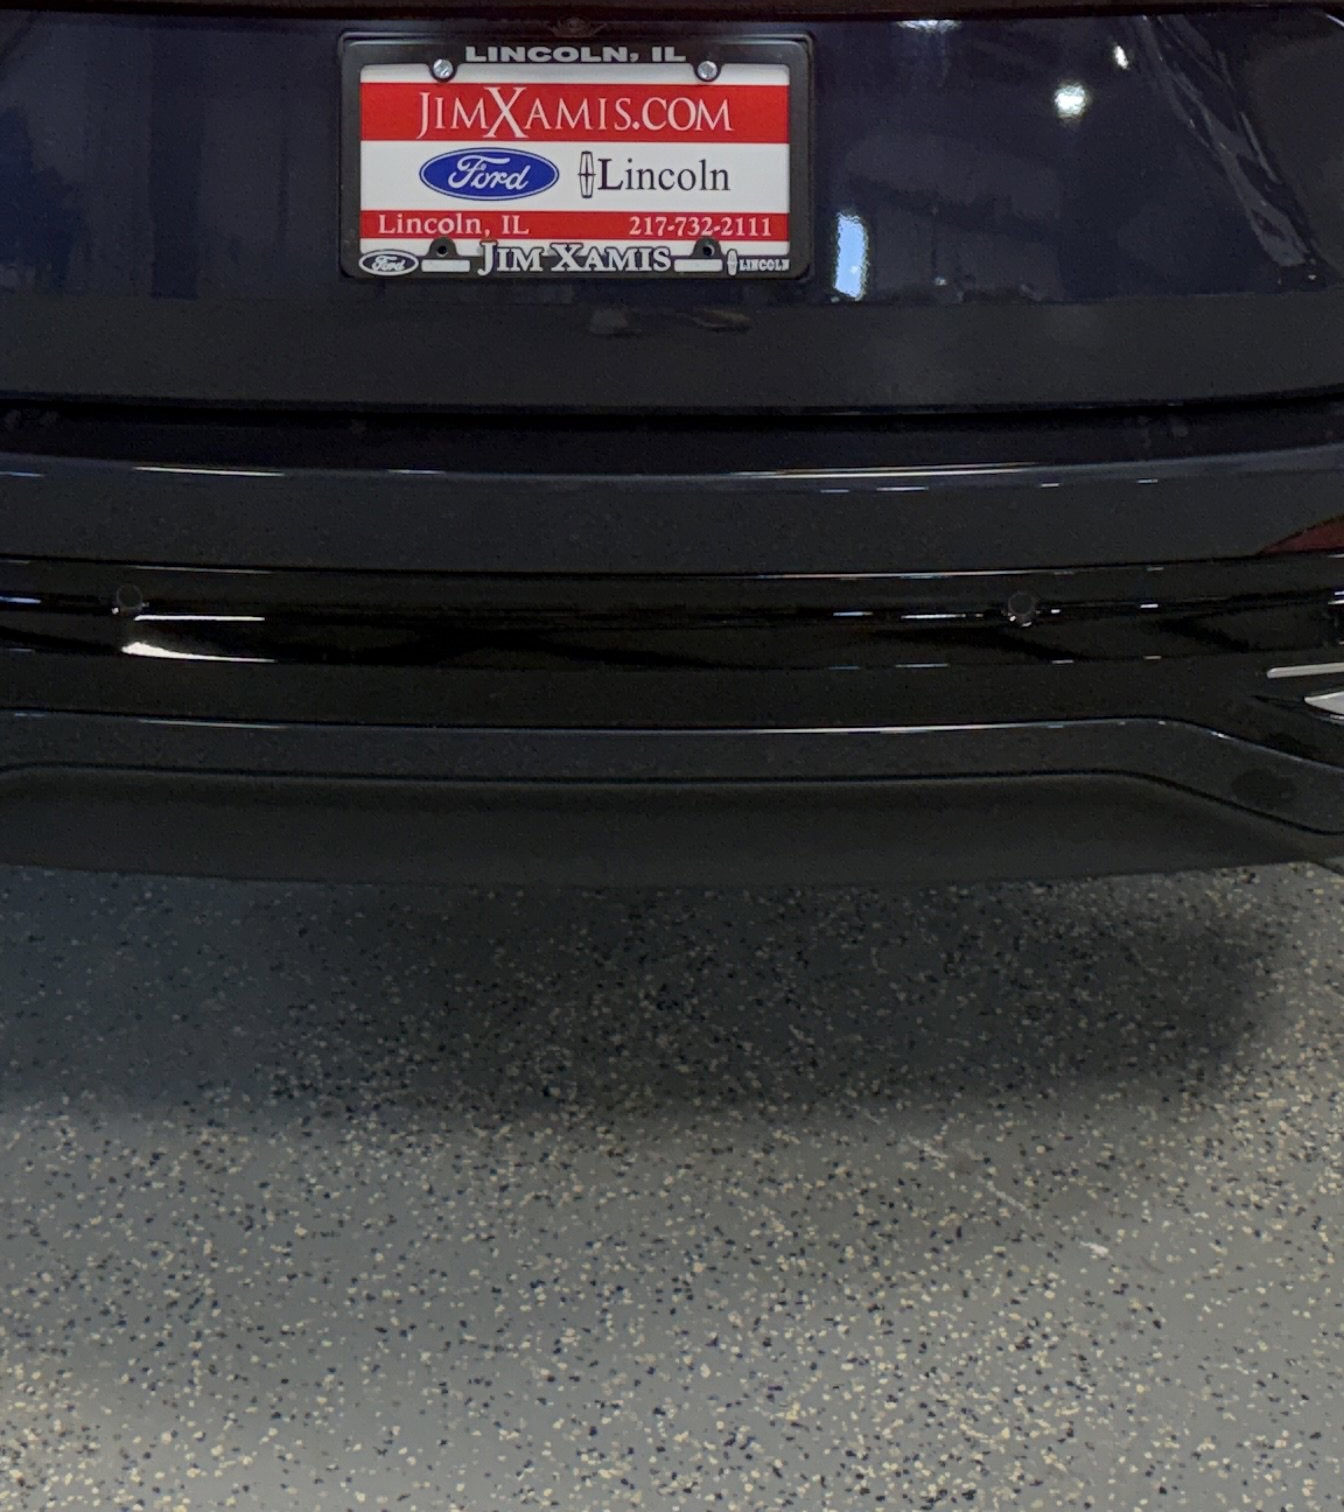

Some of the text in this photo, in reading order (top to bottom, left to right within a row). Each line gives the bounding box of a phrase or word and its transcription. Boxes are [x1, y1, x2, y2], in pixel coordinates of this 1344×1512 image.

[466, 46, 686, 63] LINCOLN, IL
[417, 87, 733, 138] JIMXAMIS.COM
[448, 154, 530, 190] Ford
[598, 158, 731, 190] Lincoln
[378, 214, 530, 237] Lincoln, IL
[629, 216, 772, 237] 217-732-2111
[477, 241, 672, 276] JIM XAMIS
[739, 258, 790, 271] LINCOLN
